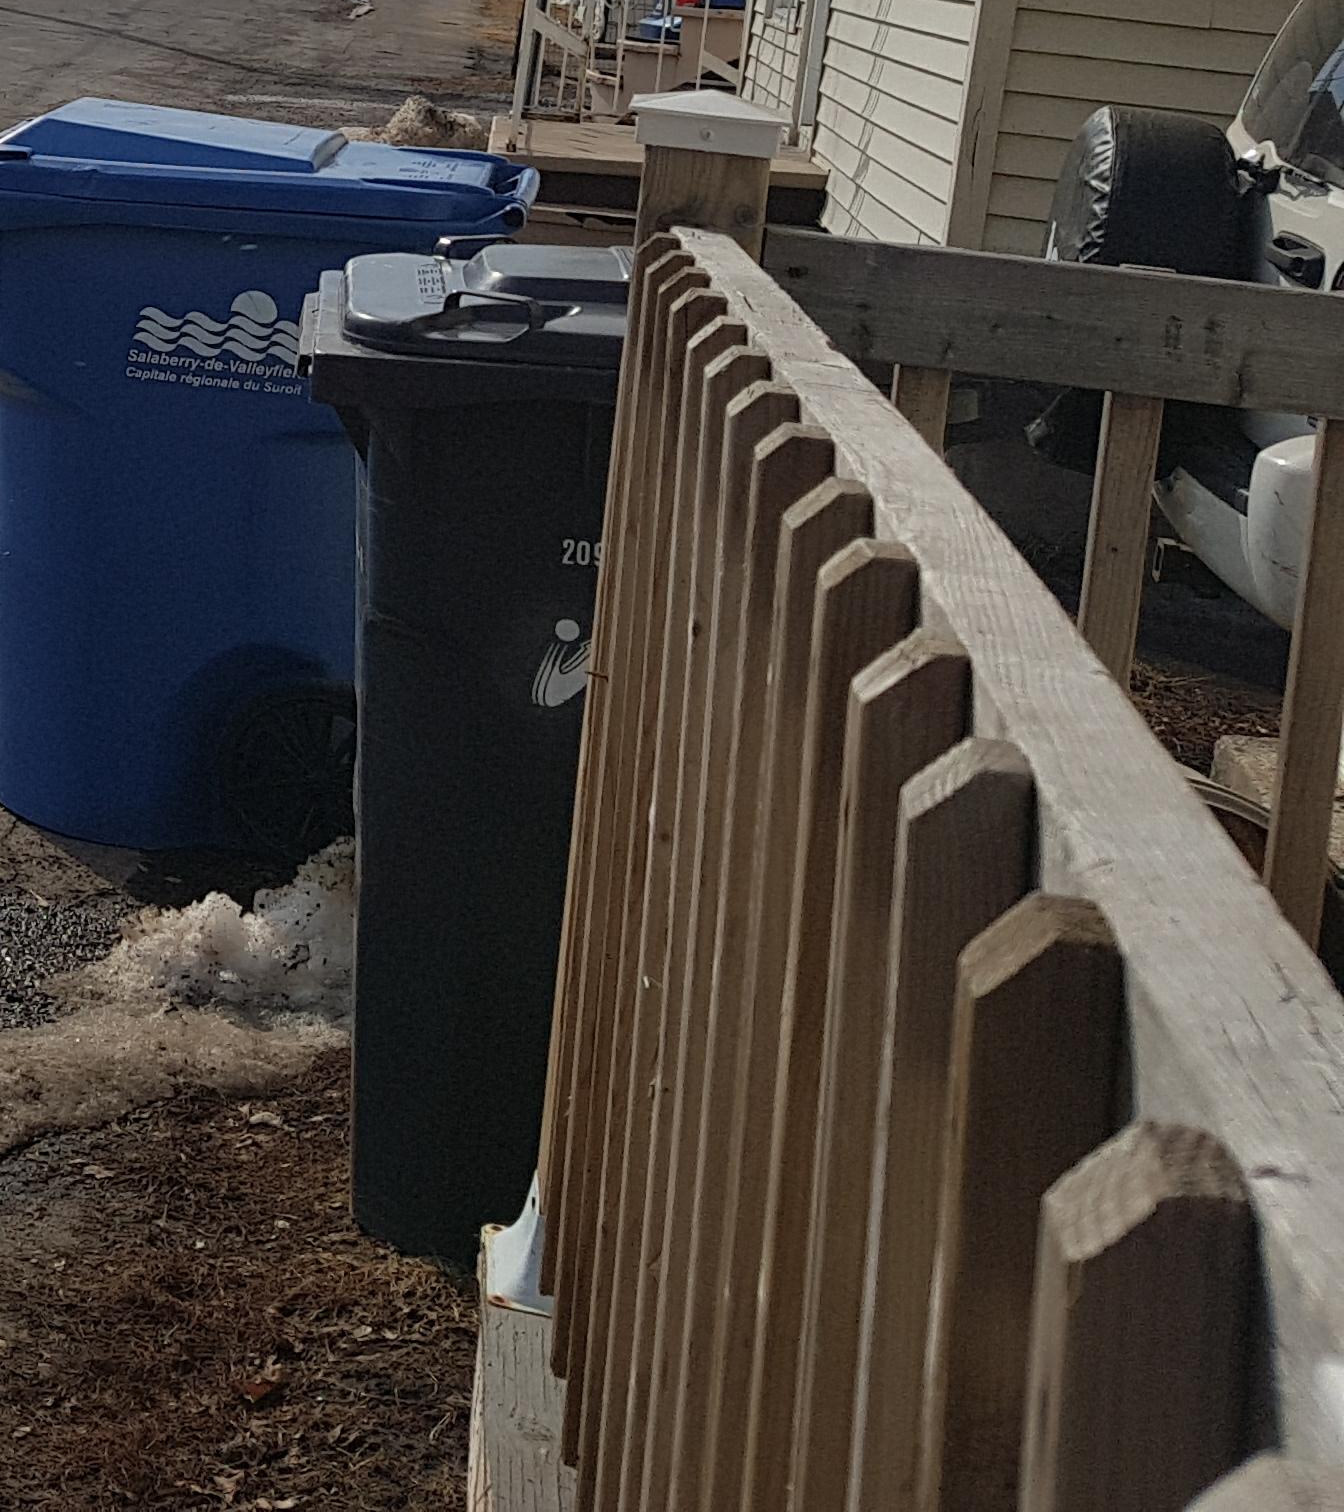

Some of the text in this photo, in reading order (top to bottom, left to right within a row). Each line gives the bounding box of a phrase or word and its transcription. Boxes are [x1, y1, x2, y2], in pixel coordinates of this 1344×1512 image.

[127, 349, 306, 379] Salaberry-de-Valleyfiel
[125, 366, 177, 382] Capitale
[179, 372, 240, 389] régionale
[243, 379, 261, 391] du
